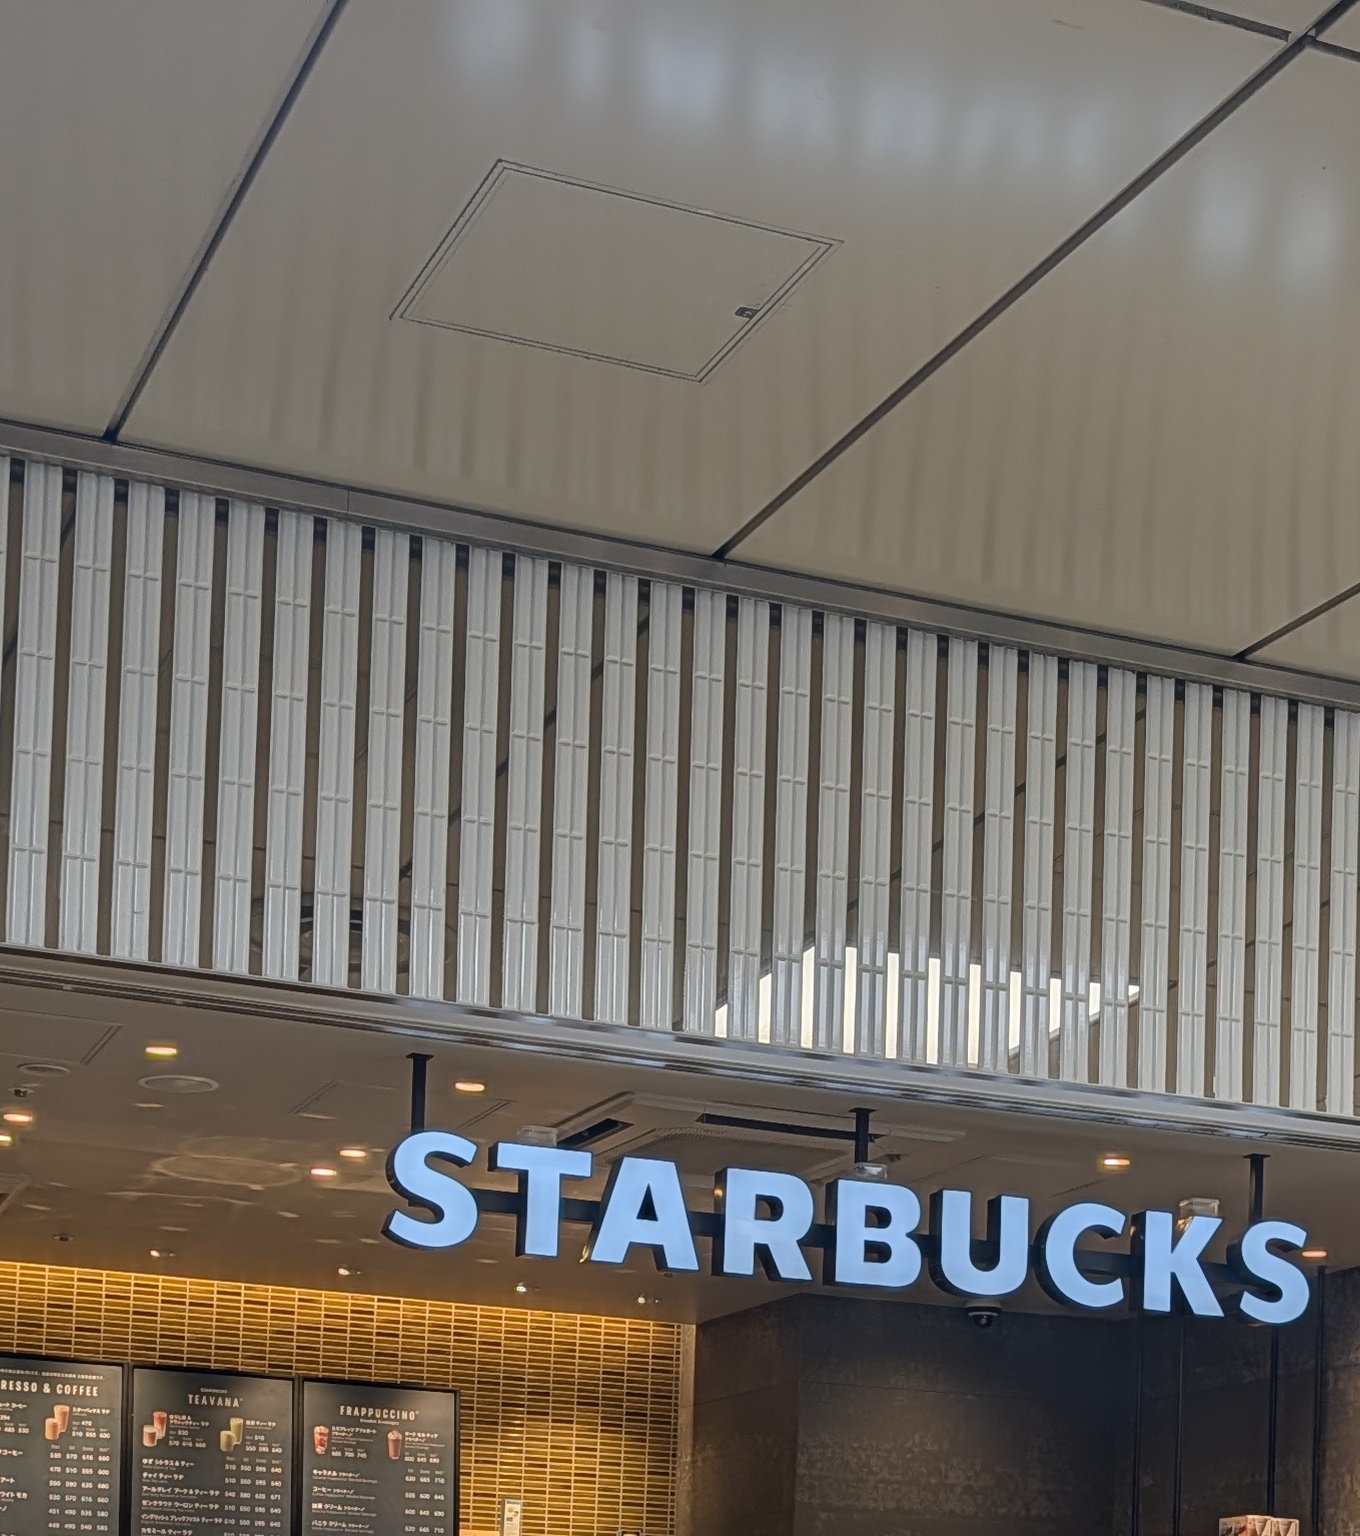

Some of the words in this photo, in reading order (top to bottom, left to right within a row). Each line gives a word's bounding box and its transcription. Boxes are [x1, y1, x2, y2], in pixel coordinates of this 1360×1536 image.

[381, 1129, 1312, 1326] STARBUCKS
[43, 1383, 51, 1393] &
[57, 1384, 98, 1396] COFFEE
[340, 1405, 415, 1420] FRAPPUCCINO
